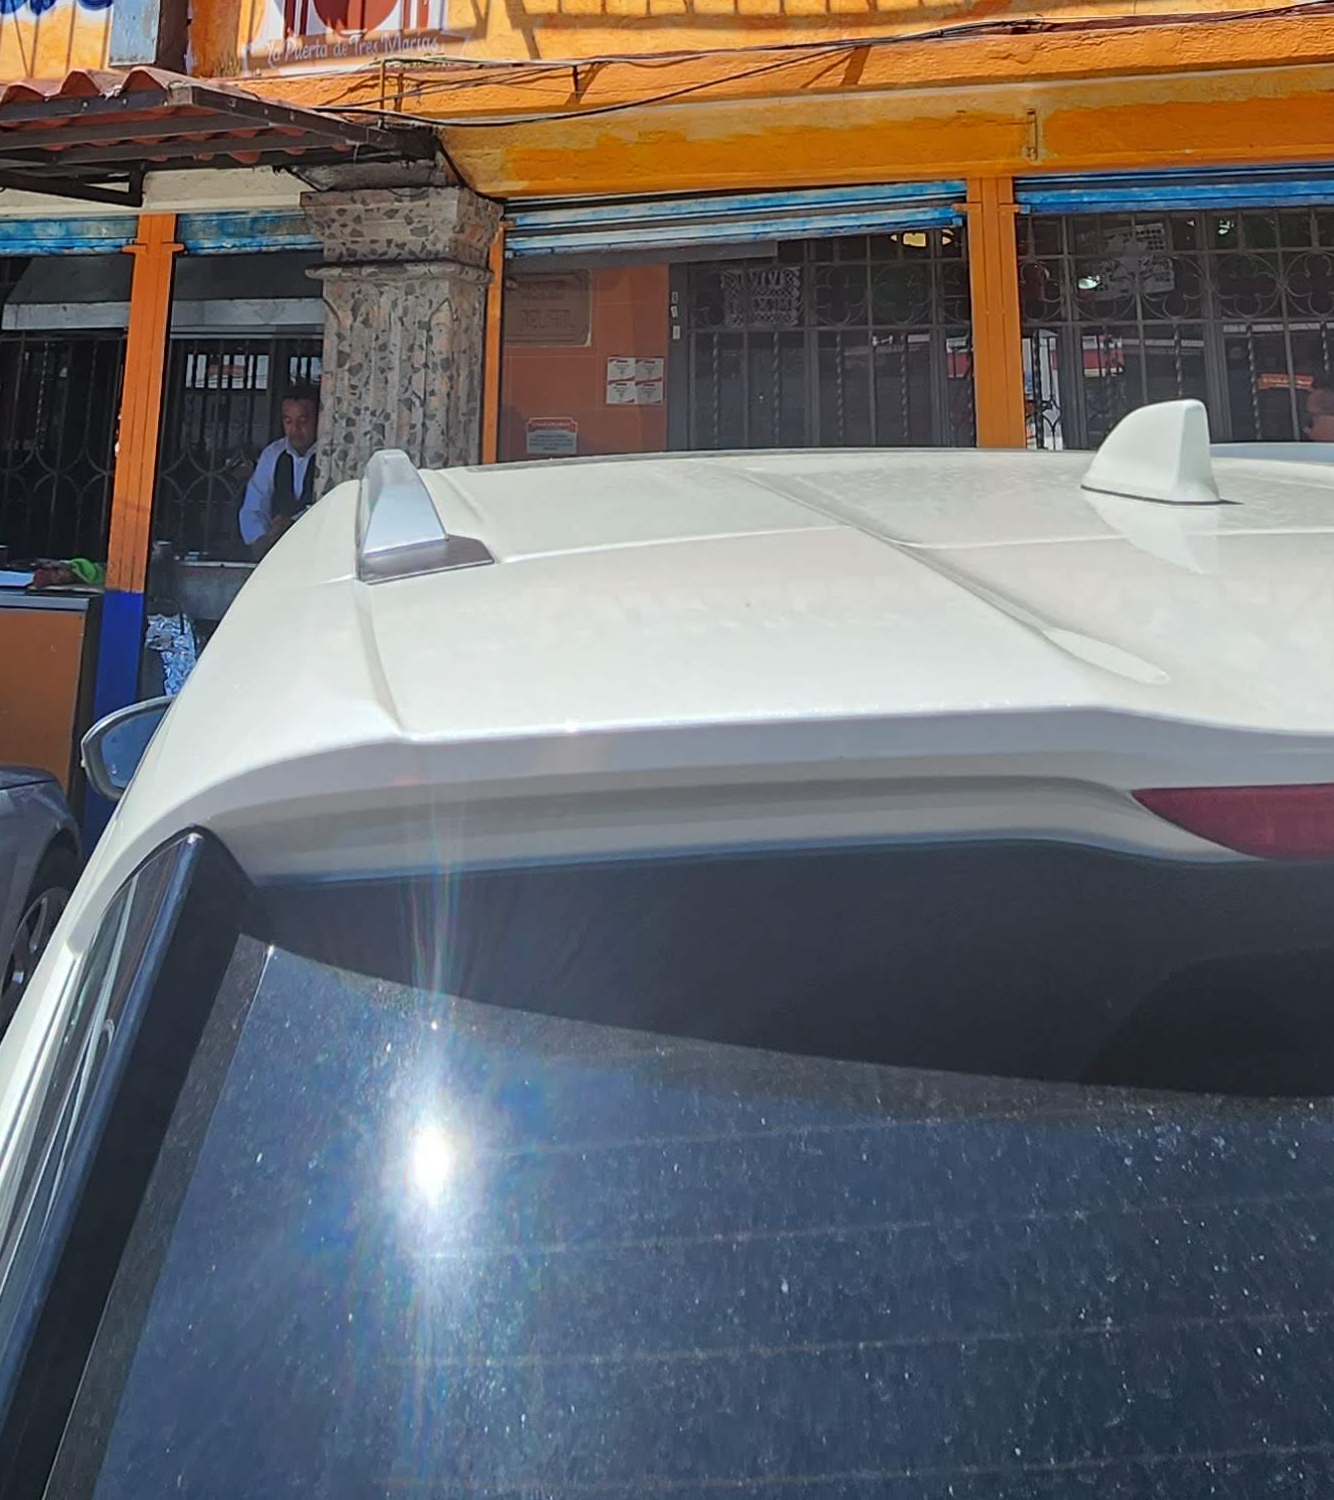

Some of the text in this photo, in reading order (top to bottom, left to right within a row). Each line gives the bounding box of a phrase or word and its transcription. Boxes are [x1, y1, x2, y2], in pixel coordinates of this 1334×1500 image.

[284, 37, 328, 61] Puerta
[333, 41, 348, 57] de
[349, 34, 378, 56] Tres
